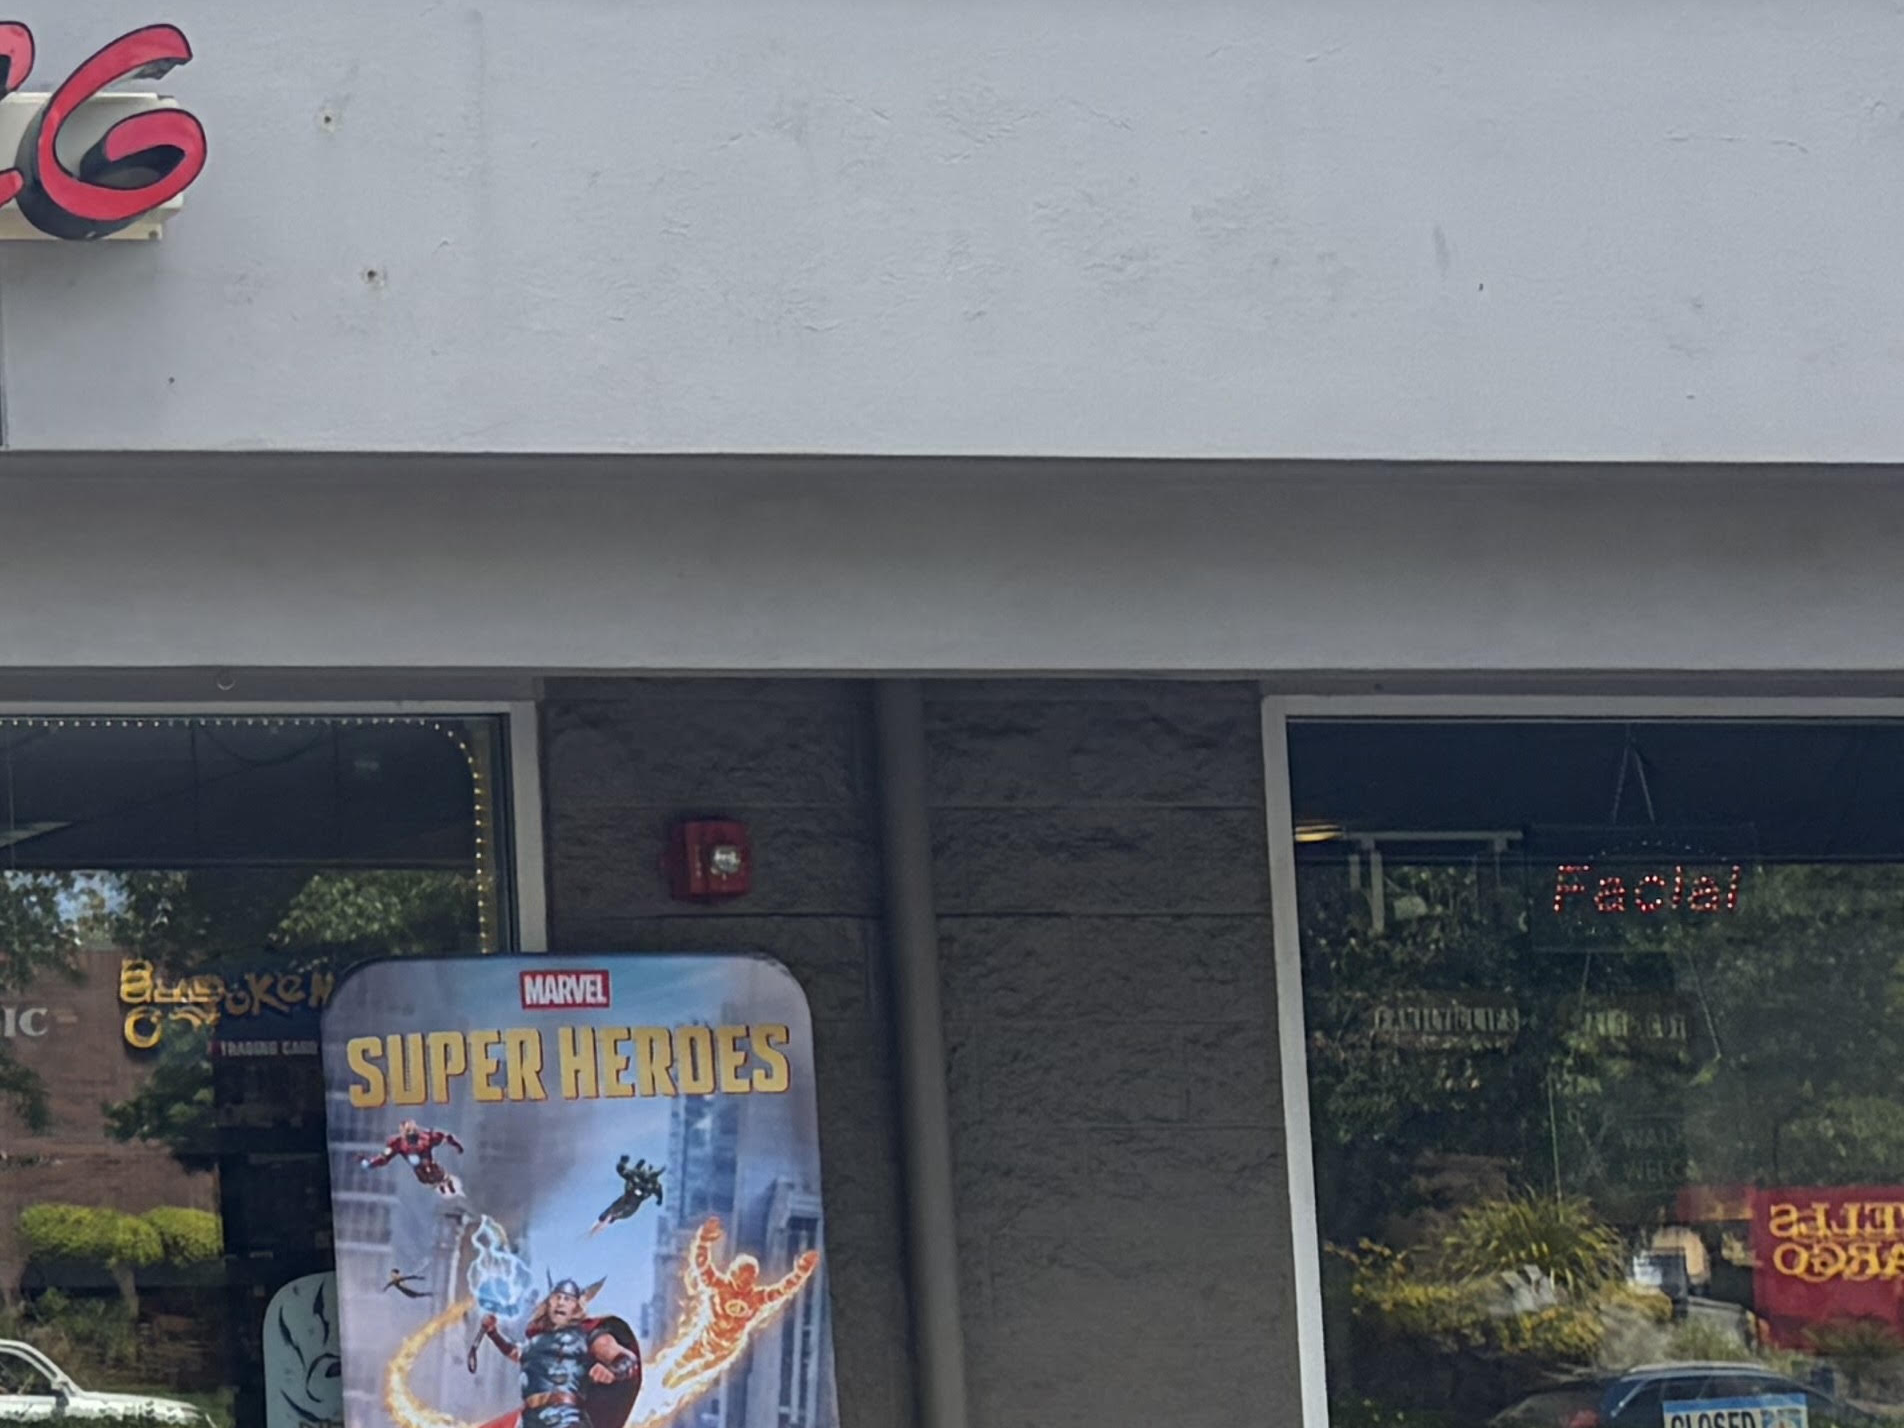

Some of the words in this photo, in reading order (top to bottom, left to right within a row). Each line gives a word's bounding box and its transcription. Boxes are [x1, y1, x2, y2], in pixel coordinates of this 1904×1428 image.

[1552, 864, 1742, 914] Facial
[523, 973, 608, 1006] MARVEL
[346, 1027, 547, 1108] SUPER
[556, 1024, 790, 1101] HEROES
